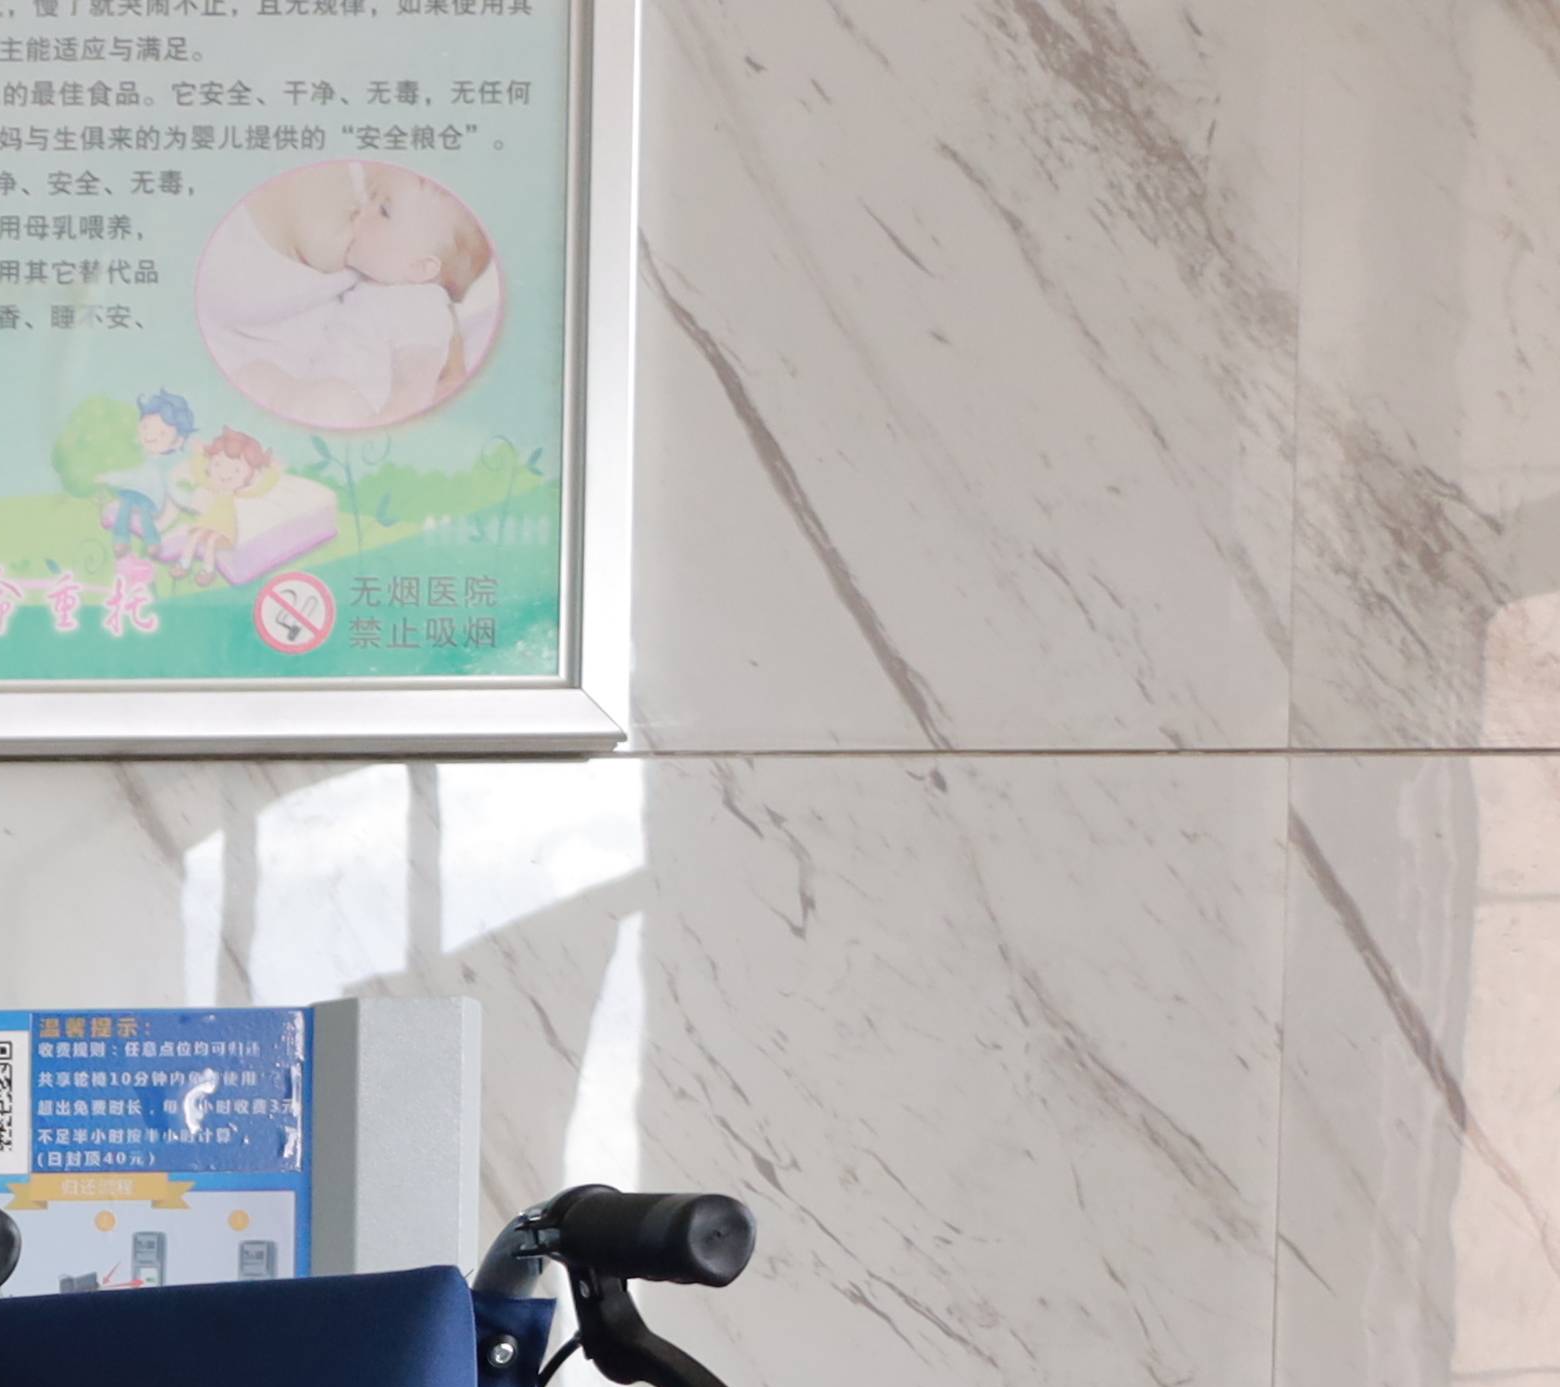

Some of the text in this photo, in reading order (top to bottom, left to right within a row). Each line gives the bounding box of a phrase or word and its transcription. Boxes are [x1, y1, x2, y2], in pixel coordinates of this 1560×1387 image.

[349, 575, 500, 609] 无烟医院
[347, 616, 498, 651] 禁止吸烟
